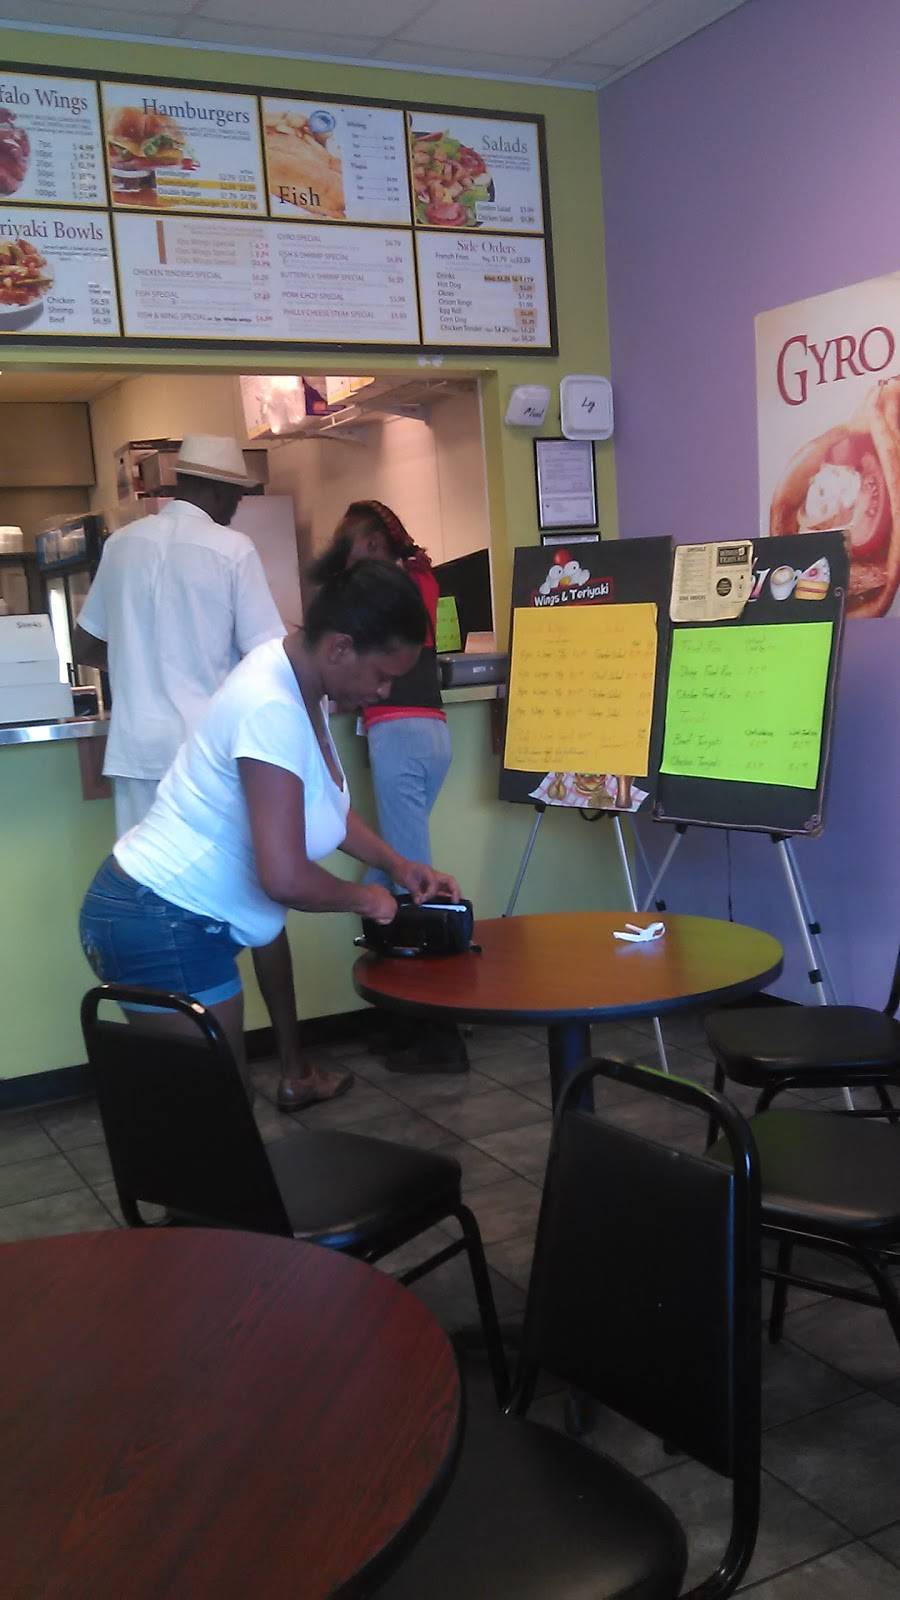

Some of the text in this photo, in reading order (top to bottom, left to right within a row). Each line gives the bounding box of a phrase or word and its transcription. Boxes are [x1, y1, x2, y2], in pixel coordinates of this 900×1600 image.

[34, 88, 88, 115] Wings
[142, 98, 251, 127] Hamburgers
[482, 135, 529, 153] Salads
[278, 185, 321, 206] Fish
[54, 220, 104, 240] Bowls
[277, 232, 295, 241] GYRO
[296, 234, 321, 242] SPECIAL
[457, 240, 517, 254] Side Orders
[132, 268, 163, 277] CHICKEN
[194, 271, 222, 280] SPECIAL
[281, 271, 315, 279] BUTTERFLY
[437, 272, 455, 280] Drinks
[450, 281, 462, 290] Dog
[135, 289, 151, 298] FISH
[47, 306, 74, 315] Shrimp
[454, 316, 467, 324] Dog
[441, 324, 464, 332] Chicken
[776, 326, 895, 406] GYRO
[534, 582, 610, 606] Wings & Teriyaki
